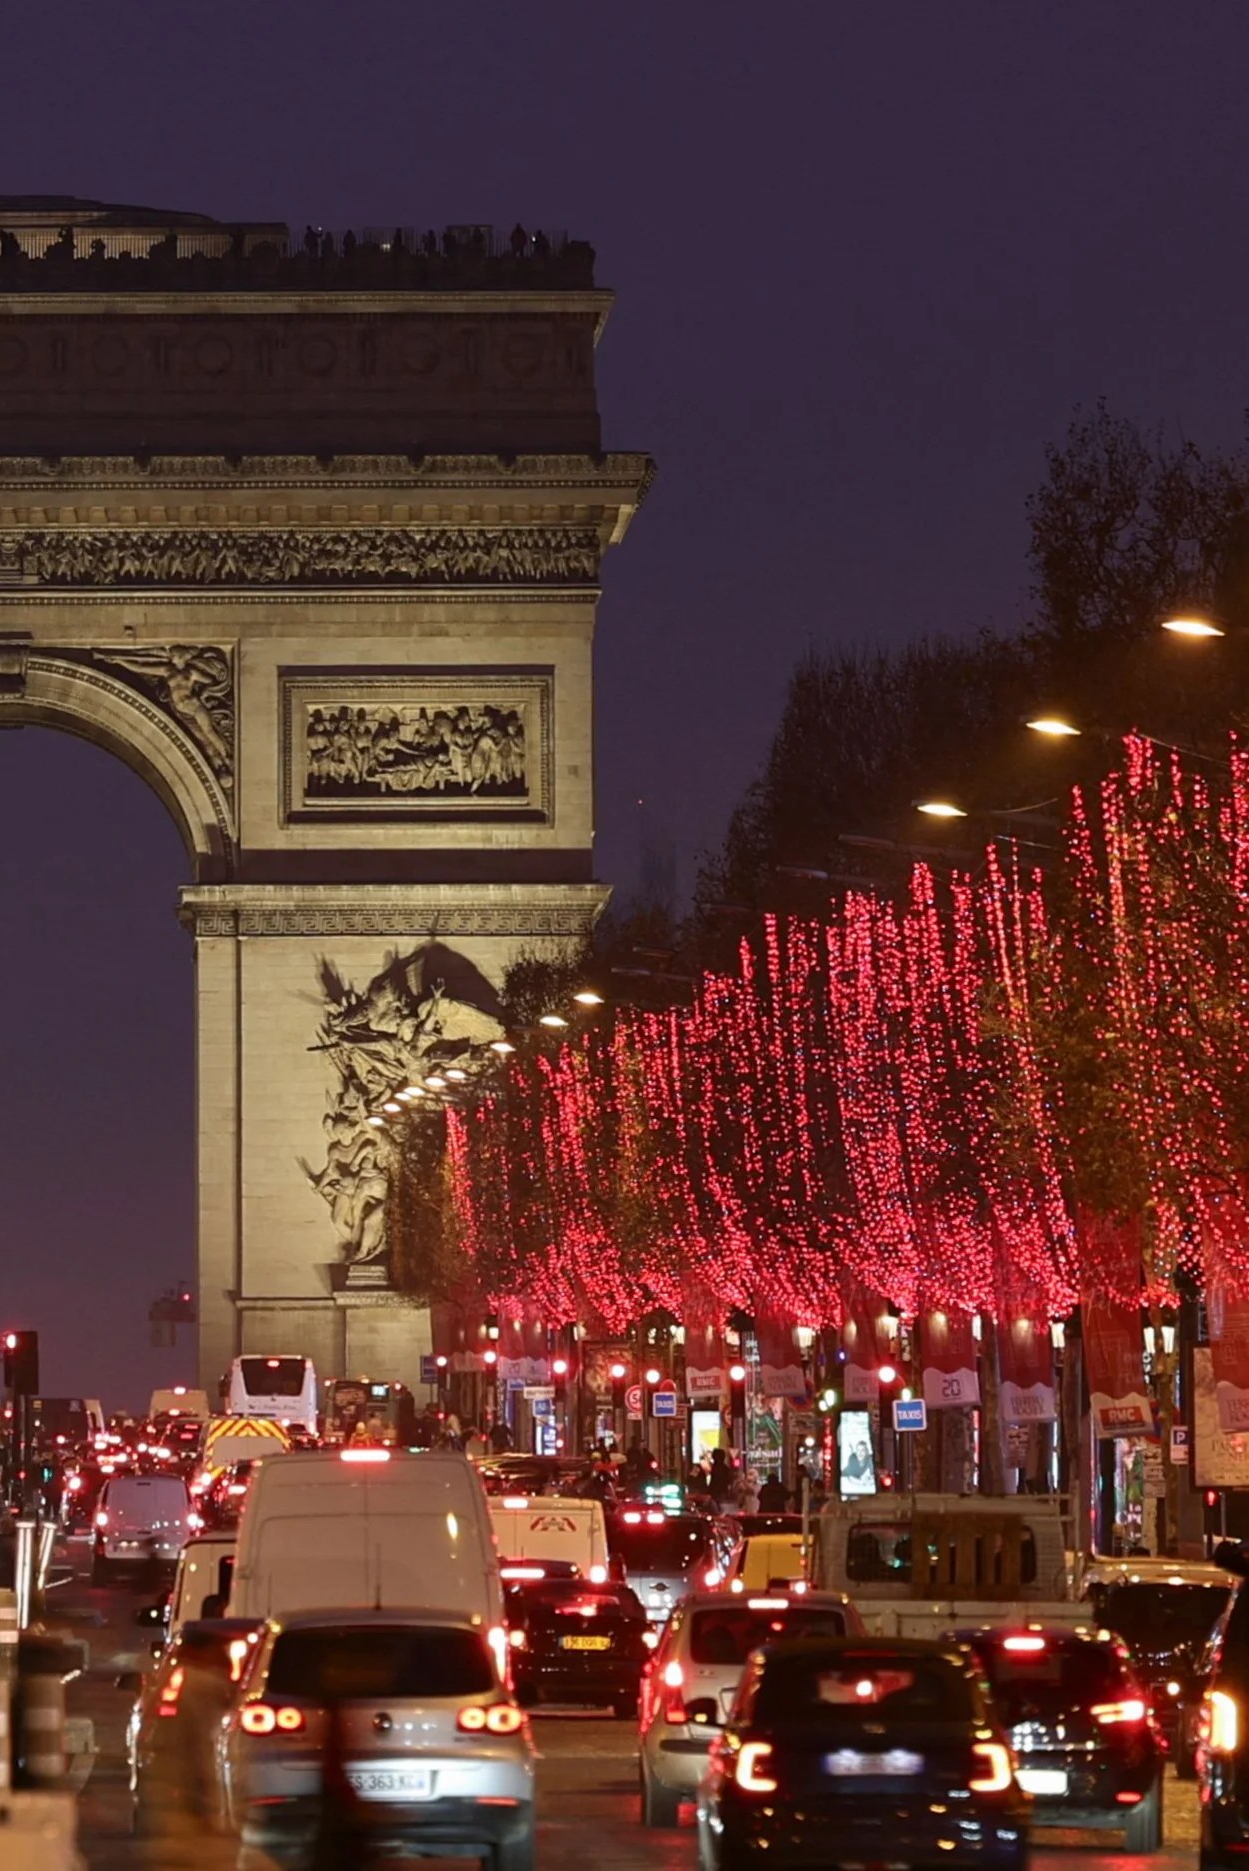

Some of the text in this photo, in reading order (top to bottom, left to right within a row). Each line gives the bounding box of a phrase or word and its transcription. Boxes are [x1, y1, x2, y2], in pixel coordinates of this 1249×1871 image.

[942, 1379, 961, 1397] 20
[897, 1410, 922, 1420] TAXIS
[1108, 1408, 1135, 1422] RMC
[1176, 1432, 1186, 1443] P
